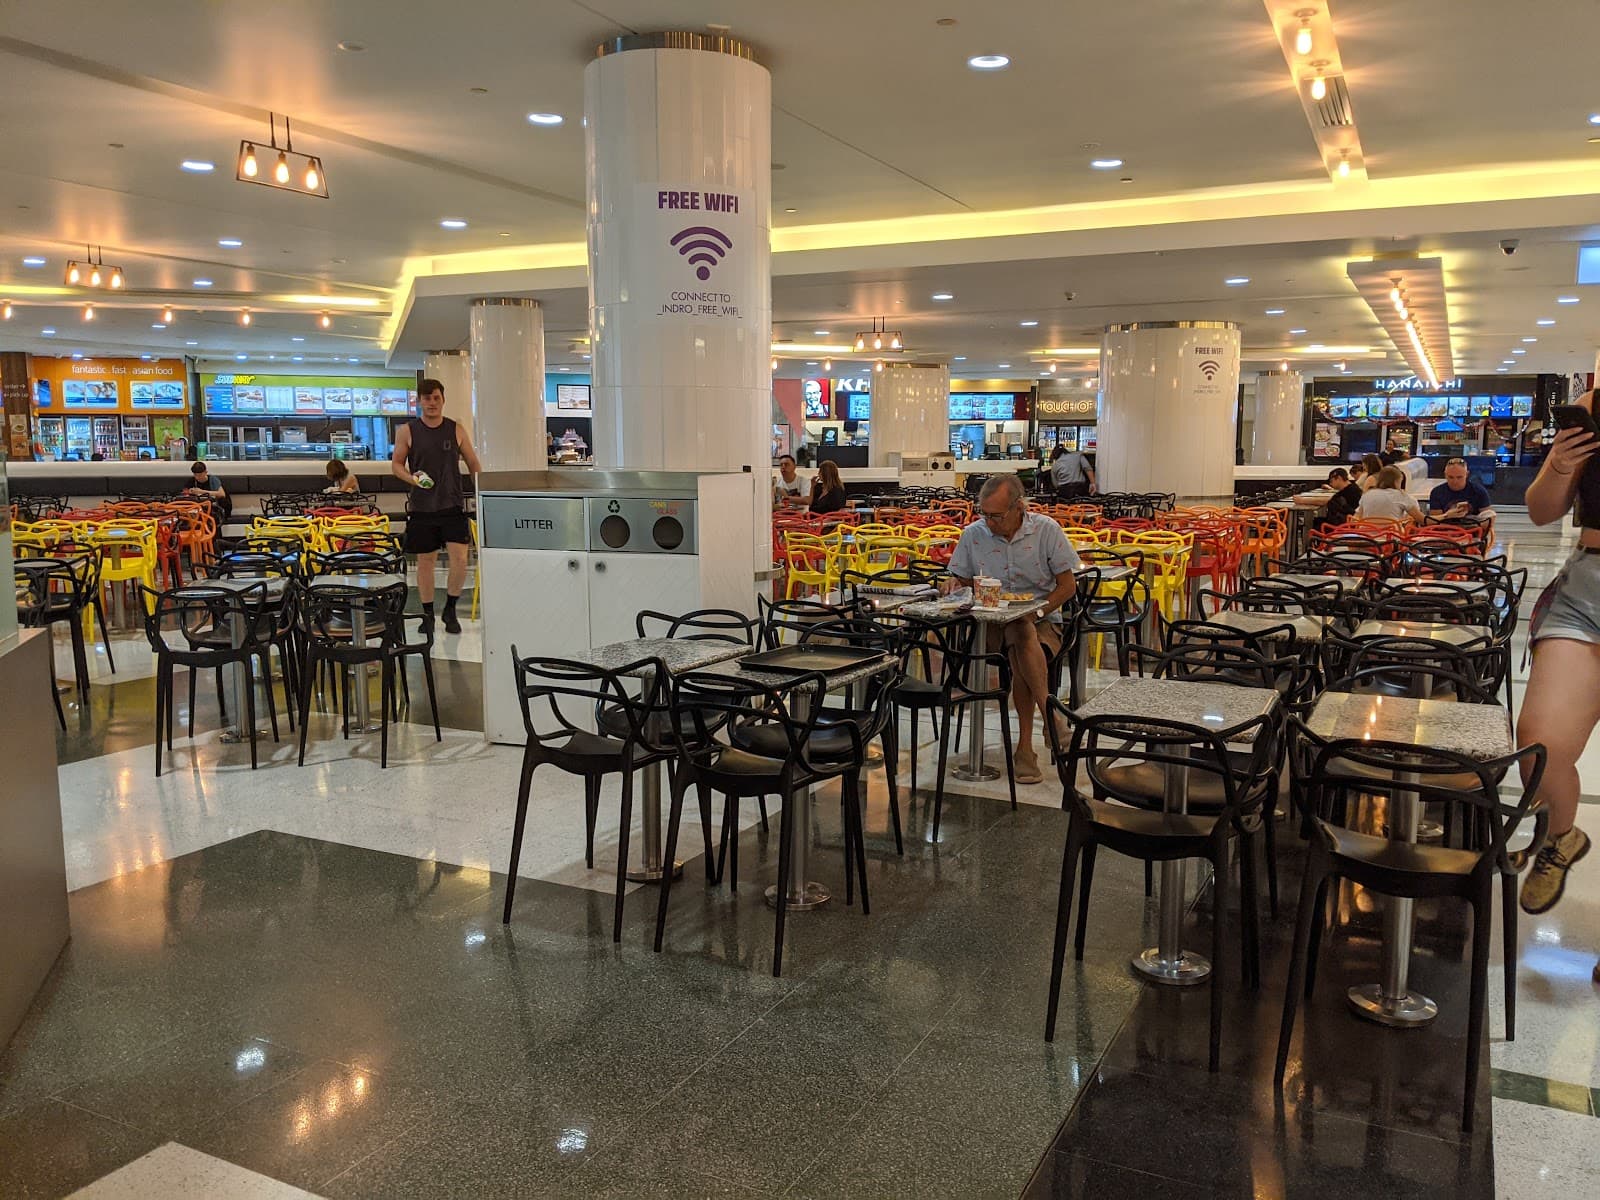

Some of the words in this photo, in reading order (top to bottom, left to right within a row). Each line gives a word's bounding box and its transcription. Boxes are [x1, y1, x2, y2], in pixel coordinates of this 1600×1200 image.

[658, 191, 700, 210] FREE
[704, 192, 739, 214] WIFI
[671, 291, 718, 303] CONNECT
[719, 294, 731, 303] TO
[1195, 347, 1210, 355] FREE
[1211, 347, 1224, 355] WIFI
[72, 365, 105, 374] fantastic
[112, 366, 126, 375] fast
[132, 366, 154, 375] asian
[155, 367, 173, 375] food
[1040, 400, 1077, 413] TOUCH
[514, 518, 553, 530] LITTER
